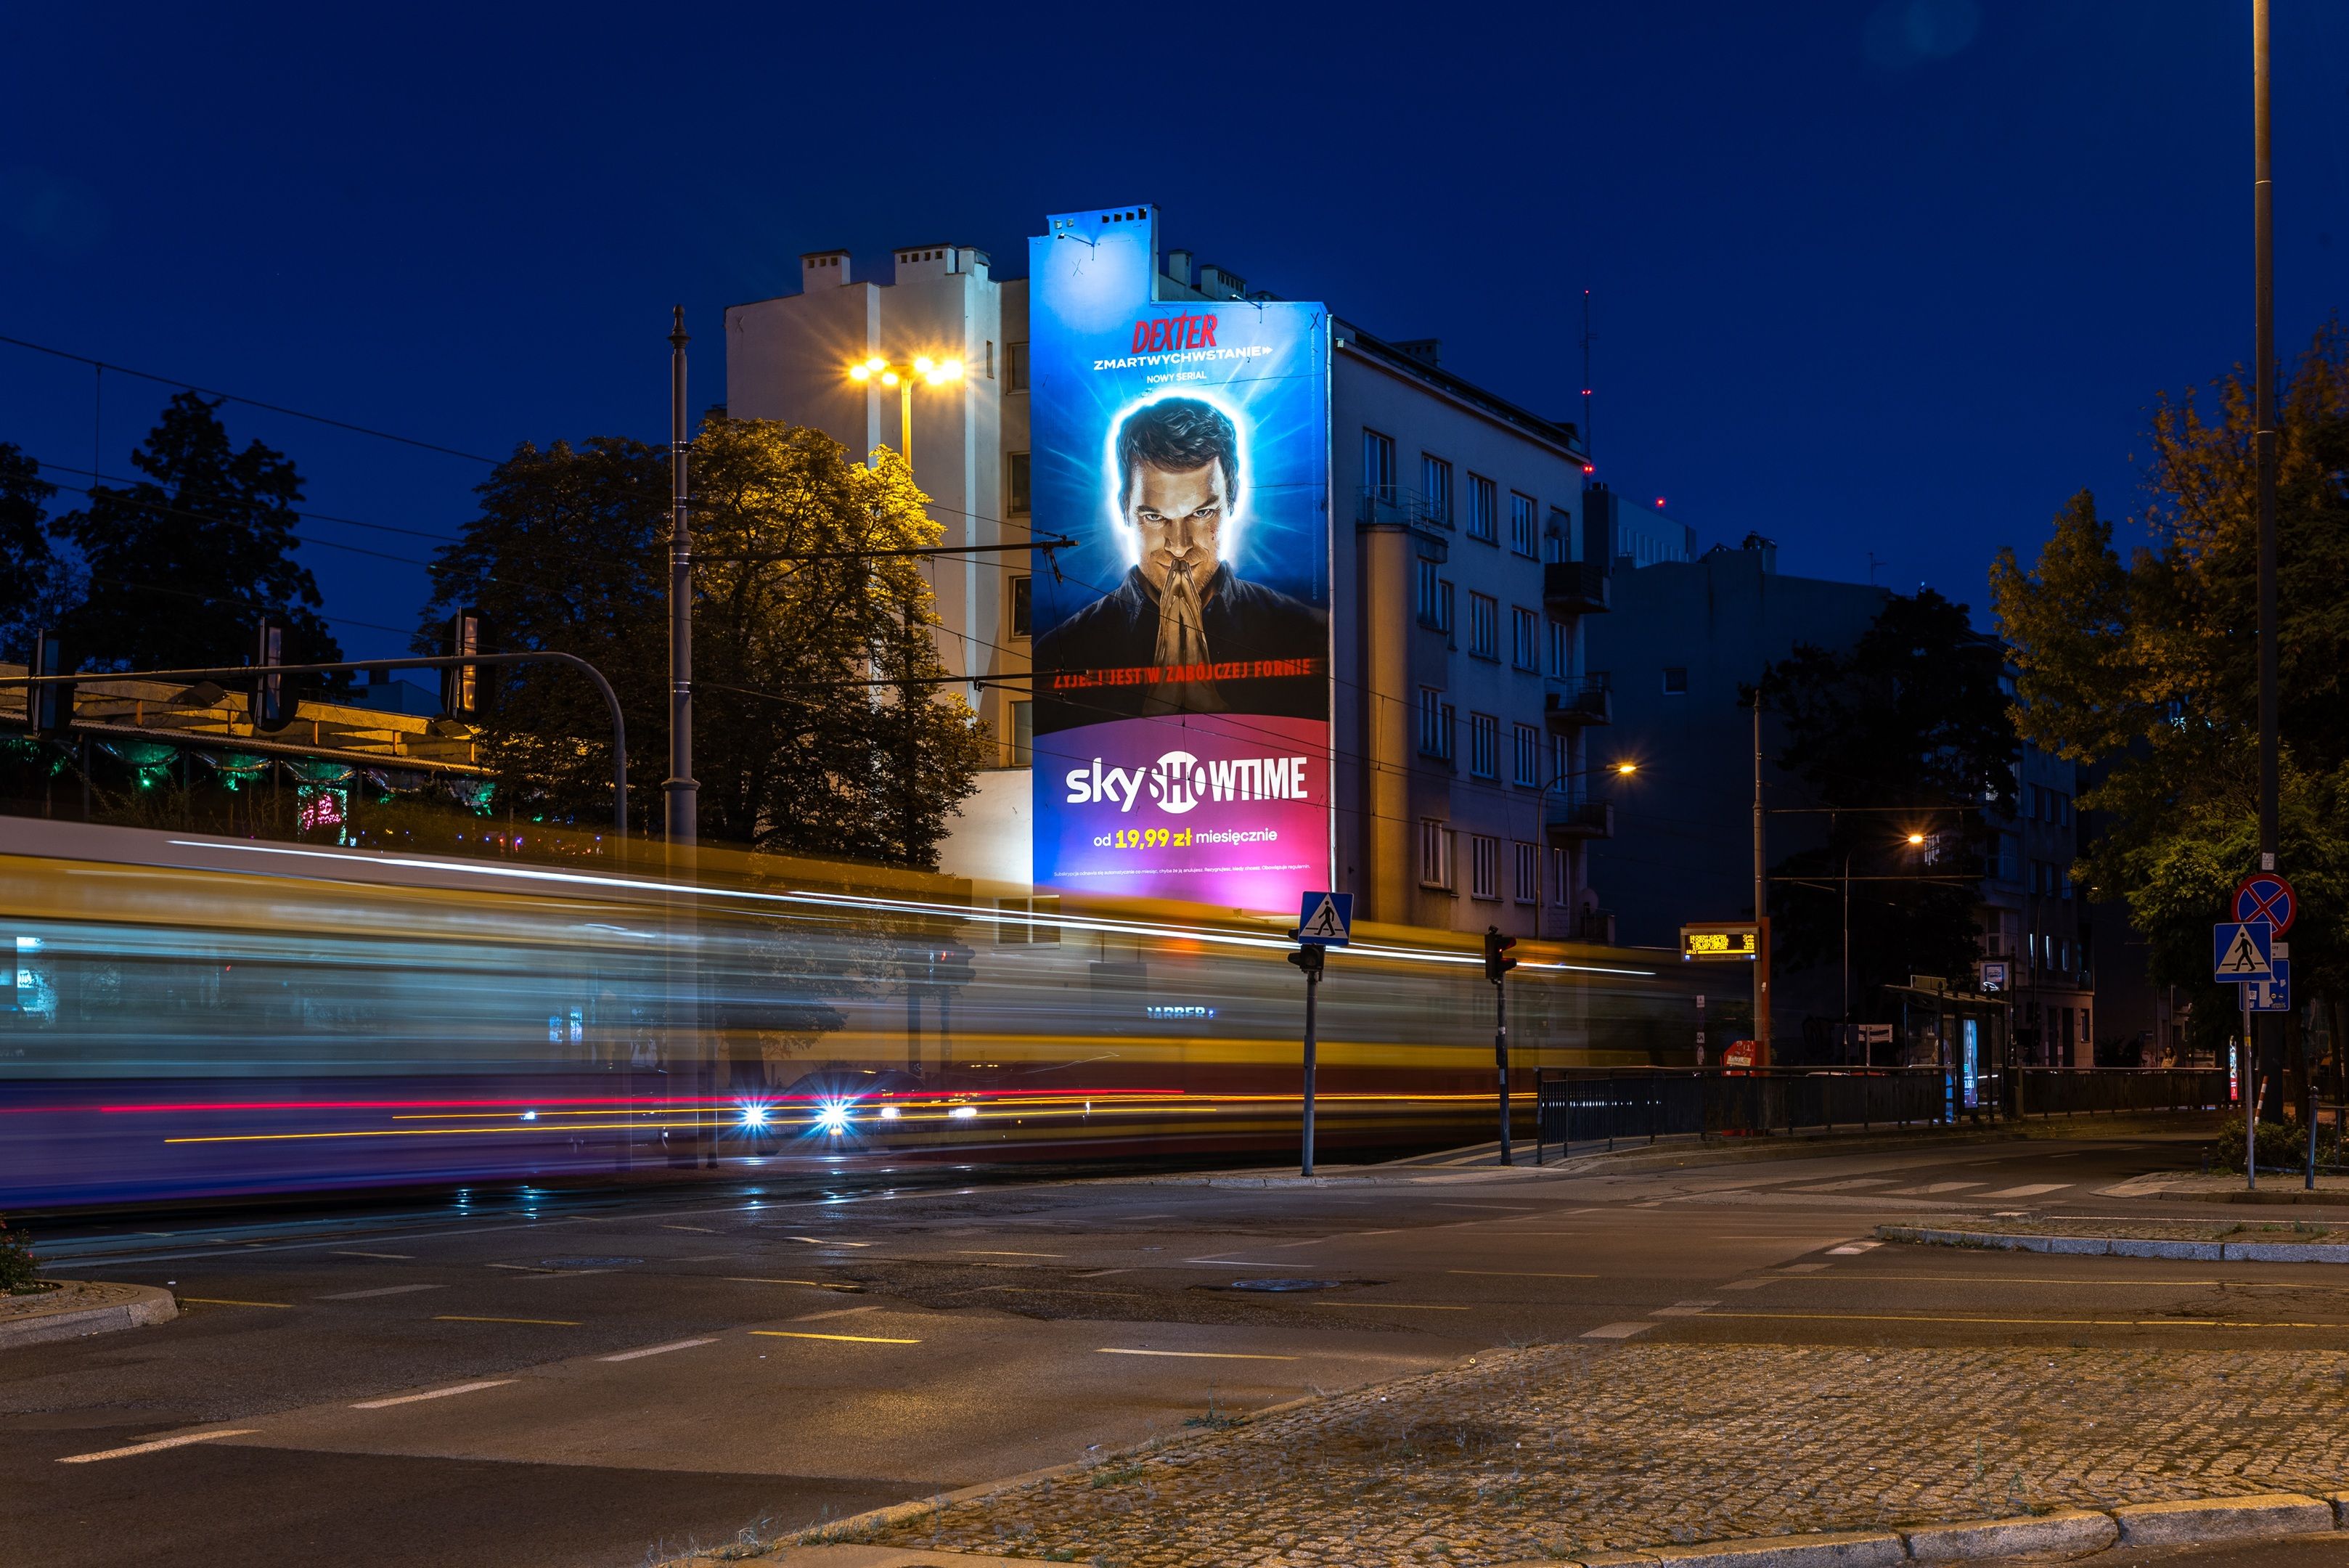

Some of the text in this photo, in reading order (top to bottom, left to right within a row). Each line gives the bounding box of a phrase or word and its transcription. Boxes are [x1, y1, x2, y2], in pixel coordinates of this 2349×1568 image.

[1131, 309, 1218, 354] DEXTER
[1093, 346, 1263, 371] ZMARTWYCHWSTANIE
[1146, 371, 1207, 384] NOWY SERIAL
[1109, 667, 1141, 686] JEST
[1147, 666, 1160, 684] W
[1166, 661, 1248, 682] ZABÓJCZEJ
[1254, 658, 1311, 678] FORMIE
[1093, 828, 1278, 850] od 19,99 zł miesięcznie
